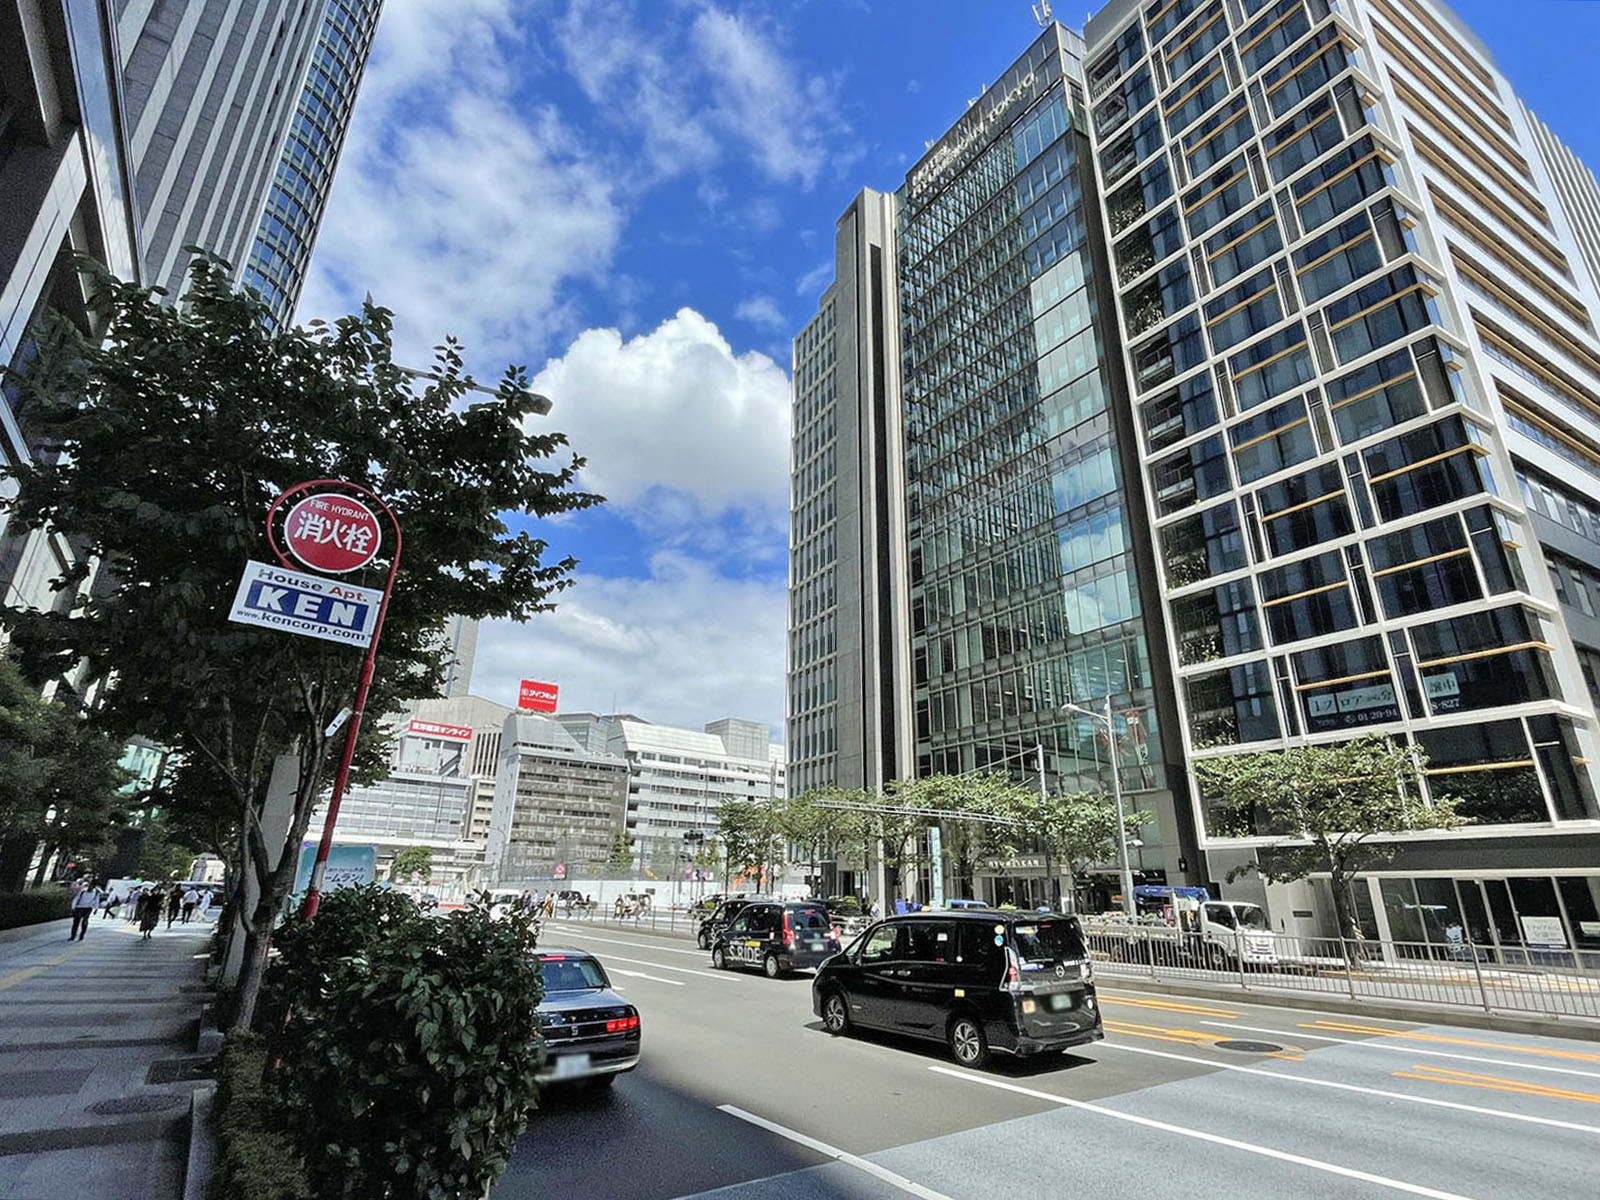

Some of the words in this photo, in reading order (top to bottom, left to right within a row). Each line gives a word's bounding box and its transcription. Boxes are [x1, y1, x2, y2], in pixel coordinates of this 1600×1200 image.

[987, 72, 1037, 122] TOKYO
[310, 499, 329, 511] FIRE
[331, 505, 369, 521] HYDRANT
[294, 510, 373, 555] 消火栓
[258, 568, 322, 591] House
[328, 586, 368, 602] Apt.
[237, 608, 365, 641] www.kencorp.com
[256, 585, 357, 627] KEN
